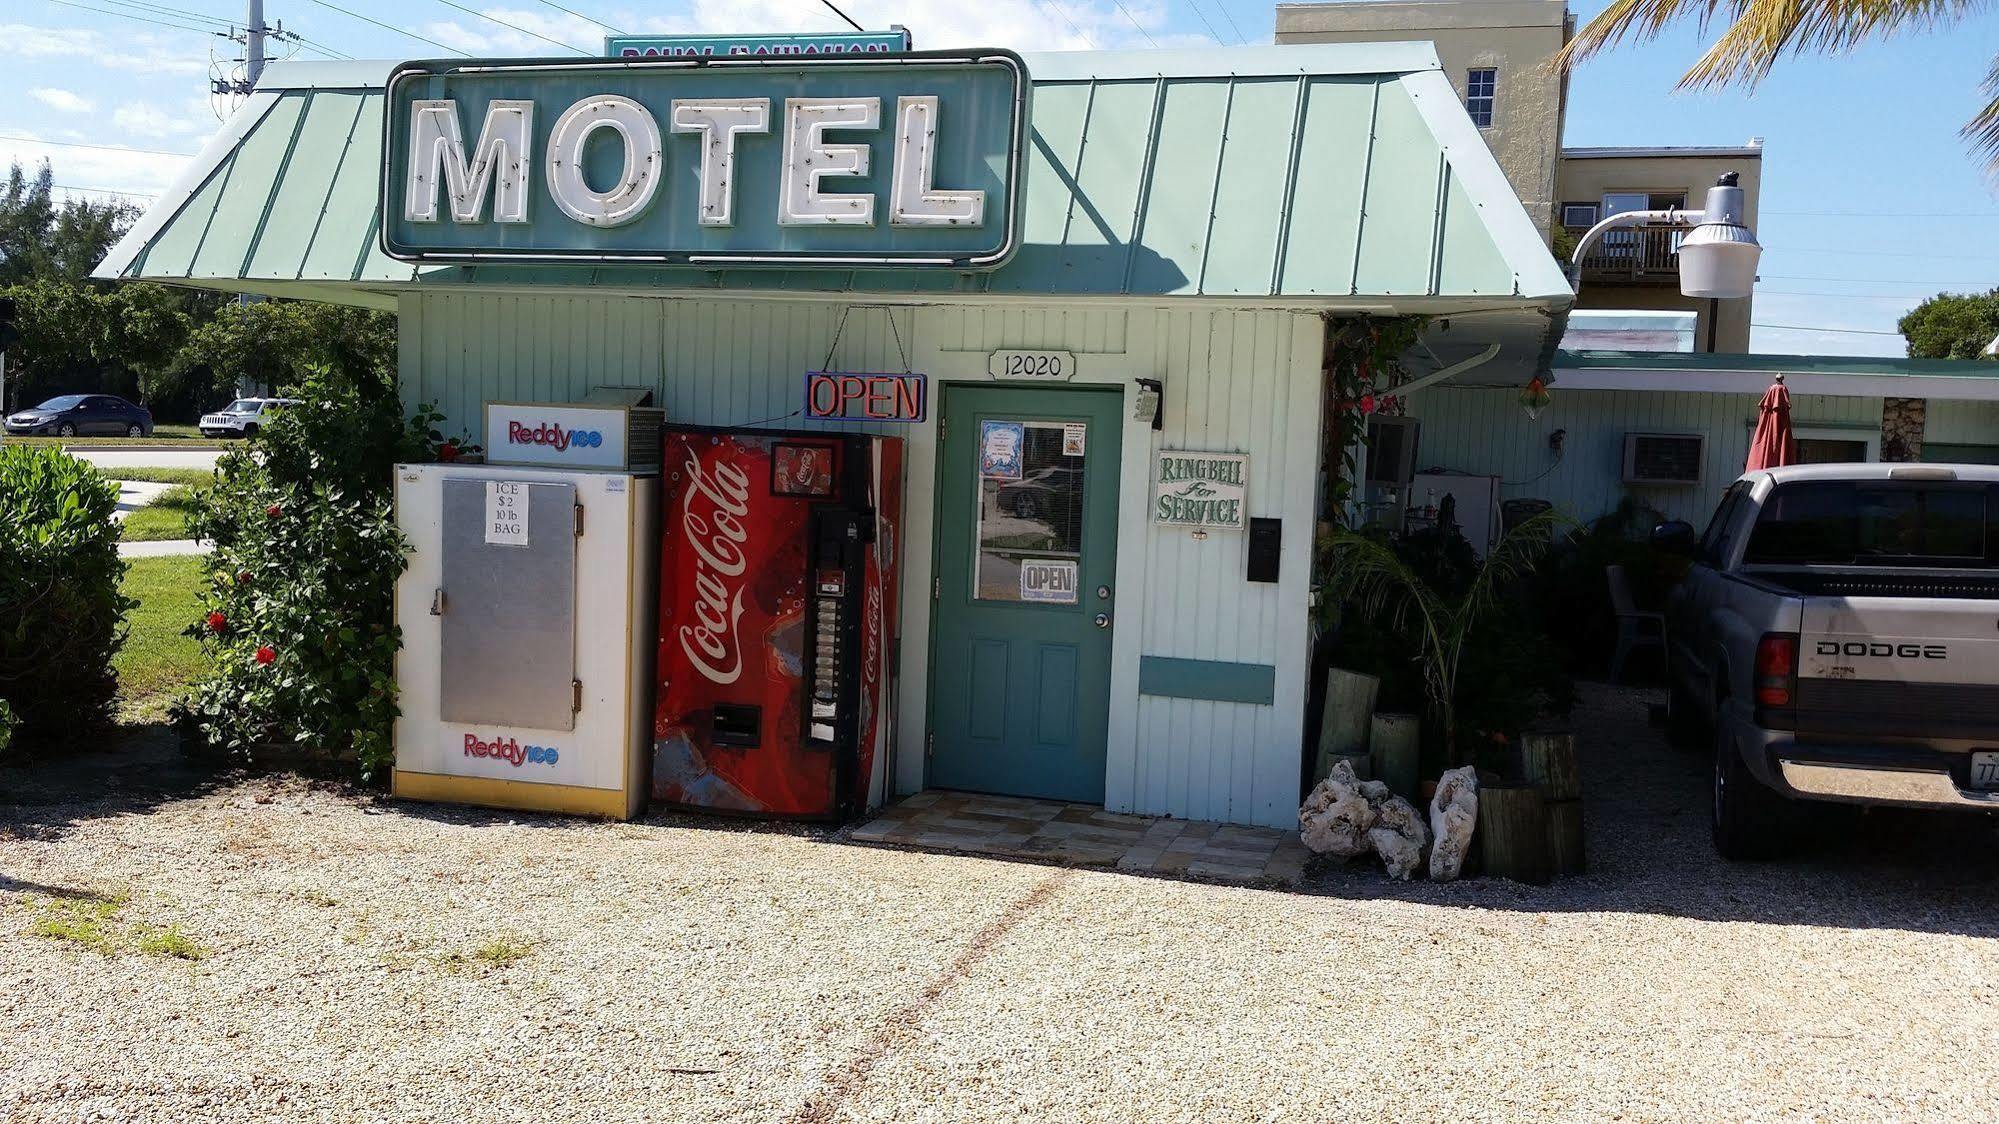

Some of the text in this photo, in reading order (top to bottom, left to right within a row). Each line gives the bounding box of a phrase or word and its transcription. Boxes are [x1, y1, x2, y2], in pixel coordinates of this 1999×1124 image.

[404, 94, 985, 229] MOTEL
[1004, 354, 1062, 377] 12020
[809, 375, 920, 418] OPEN
[496, 483, 519, 495] ICE
[496, 509, 518, 521] 10 lb
[1157, 494, 1241, 526] SERVICE
[494, 522, 521, 535] BAG
[679, 444, 749, 685] Coca-Cola
[1026, 566, 1072, 591] OPEN
[1816, 641, 1947, 659] DODGE
